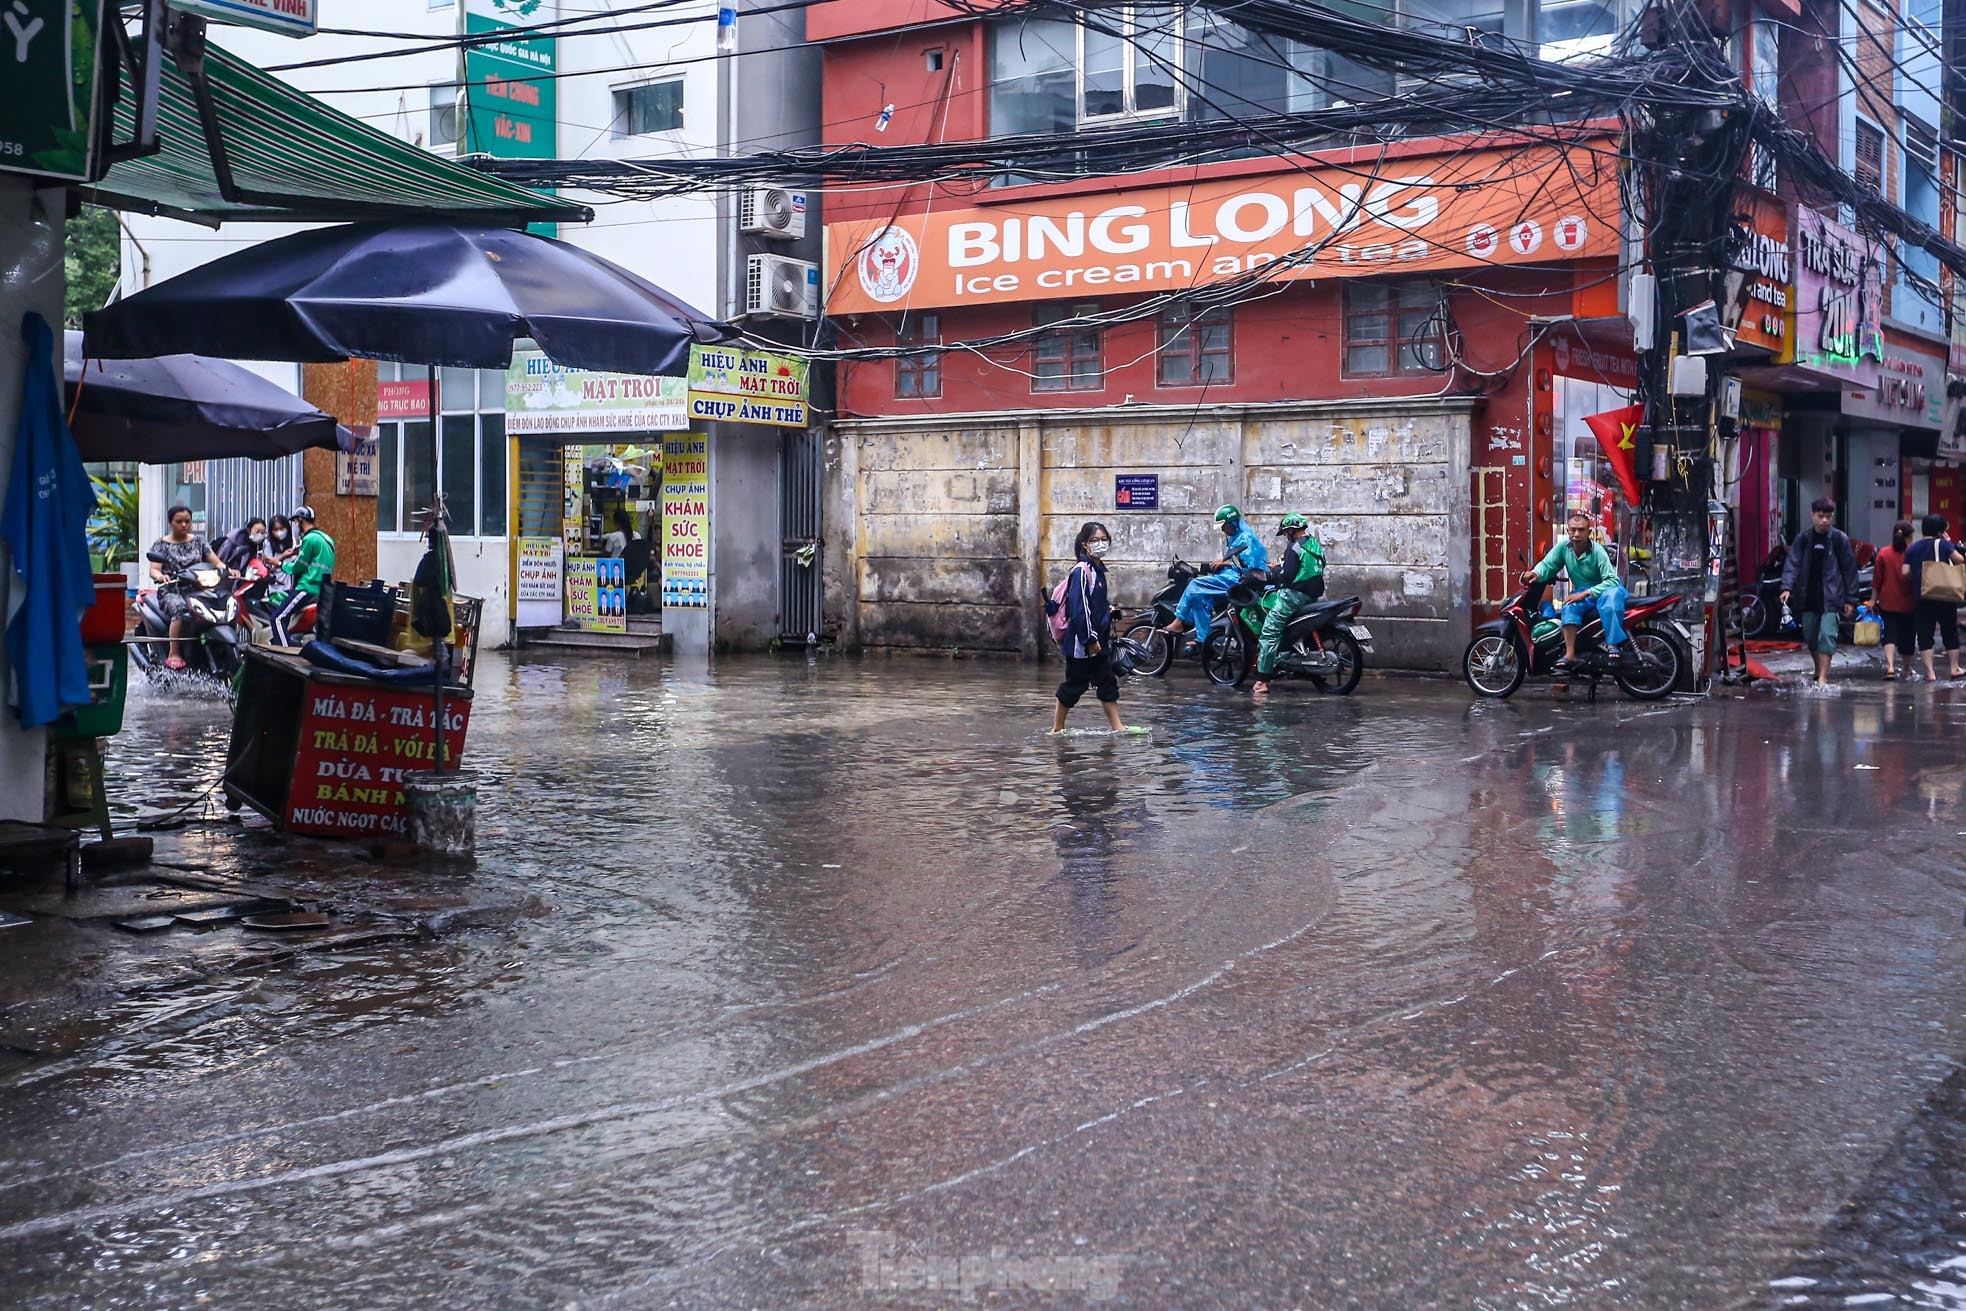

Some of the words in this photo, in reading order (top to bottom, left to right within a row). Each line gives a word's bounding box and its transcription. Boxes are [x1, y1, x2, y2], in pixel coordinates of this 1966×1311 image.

[518, 48, 529, 60] GIA
[0, 142, 23, 156] 58
[948, 205, 1150, 268] BING
[1170, 175, 1440, 249] LONG
[955, 273, 1020, 296] Ice
[1036, 259, 1192, 289] cream
[1335, 240, 1429, 267] tea
[1773, 288, 1786, 307] tea
[701, 350, 735, 372] HIỆU
[738, 351, 768, 374] ẢNH
[583, 375, 617, 404] MẶT
[740, 374, 768, 395] MẶT
[770, 377, 800, 396] TRỜI
[693, 399, 737, 419] CHỤP
[738, 398, 772, 420] ẢNH
[774, 403, 804, 424] THẺ
[534, 418, 544, 430] LAO
[561, 416, 575, 430] CHỤP
[665, 440, 685, 456] HIỆU
[686, 437, 705, 454] ẢNH
[665, 485, 687, 496] CHỤP
[688, 481, 706, 494] ẢNH
[665, 498, 705, 516] KHÁM
[672, 519, 698, 537] SỨC
[520, 570, 540, 581] CHỤP
[542, 568, 557, 580] ẢNH
[582, 560, 596, 573] ẢNH
[573, 588, 588, 600] SỨC
[312, 694, 346, 719] MÍA
[350, 699, 376, 722] ĐÁ
[390, 705, 424, 728] TRÀ
[313, 728, 349, 750] TRÀ
[353, 730, 379, 755] ĐÁ
[393, 732, 424, 758] VỐI
[316, 757, 372, 781] DỪA
[316, 782, 388, 805] BÁNH
[292, 806, 335, 826] NƯỚC
[337, 813, 377, 833] NGỌT
